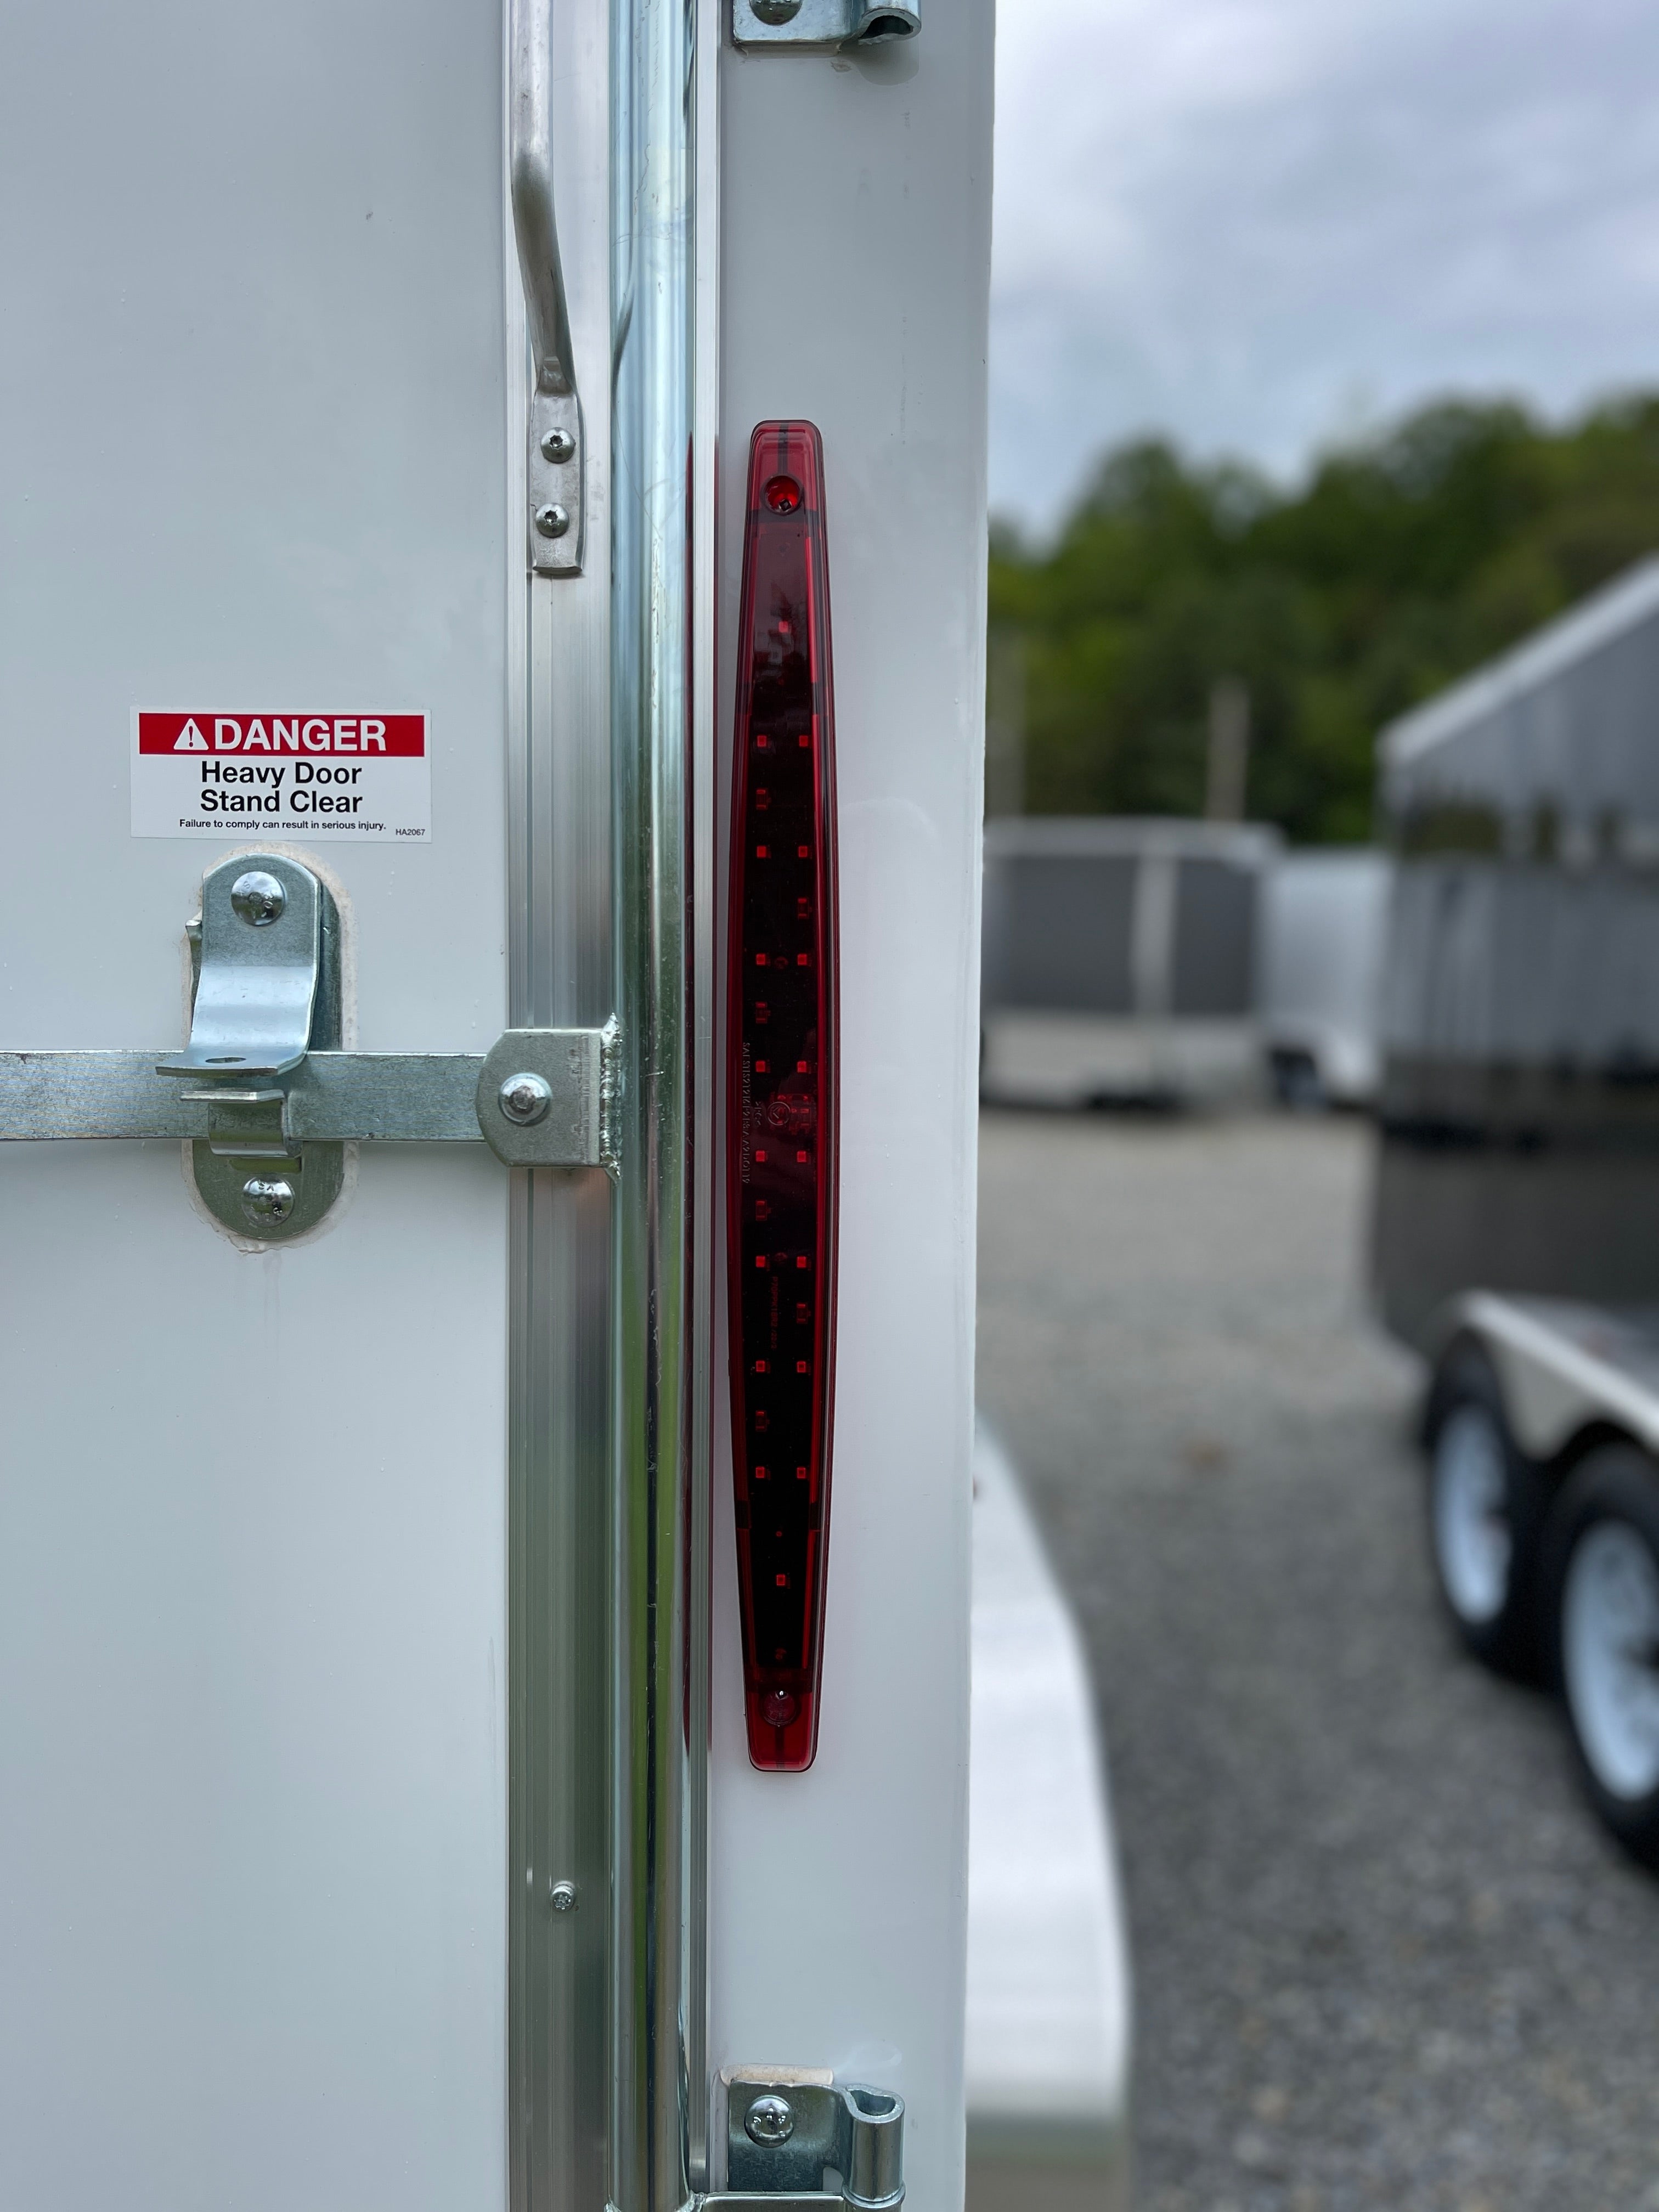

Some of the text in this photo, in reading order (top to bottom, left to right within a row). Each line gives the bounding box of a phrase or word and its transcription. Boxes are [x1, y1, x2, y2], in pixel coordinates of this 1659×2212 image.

[215, 719, 386, 751] DANGER
[202, 760, 362, 788] Heavy Door
[200, 789, 363, 813] Stand Clear
[179, 819, 211, 828] Failure
[213, 820, 223, 828] to
[225, 820, 260, 830] comply
[282, 820, 309, 829] result
[311, 820, 319, 829] in
[321, 821, 356, 830] serious
[358, 821, 386, 831] injury.
